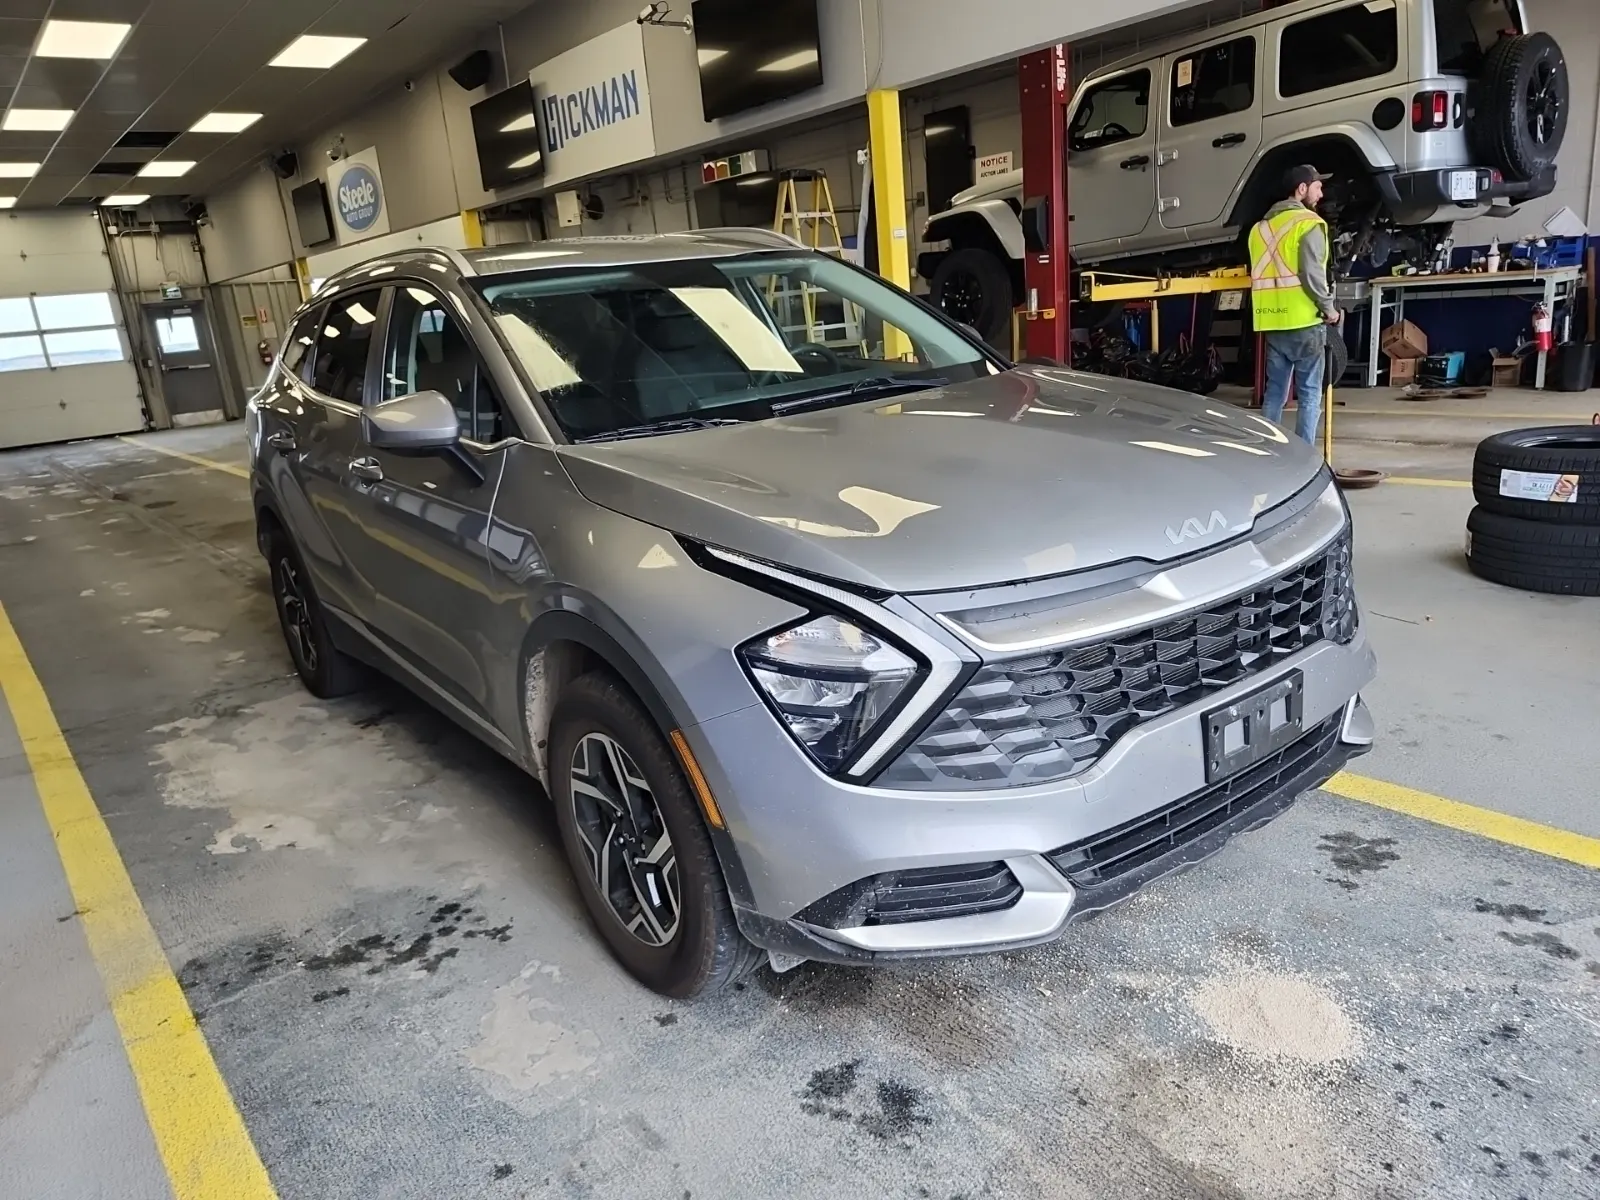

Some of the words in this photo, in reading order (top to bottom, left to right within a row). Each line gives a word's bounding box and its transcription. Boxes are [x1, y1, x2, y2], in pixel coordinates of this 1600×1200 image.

[541, 69, 640, 153] HICKMAN
[980, 156, 1008, 168] NOTICE
[340, 179, 375, 213] Steele
[346, 211, 358, 222] AUTO
[358, 206, 373, 219] GROUP
[1164, 510, 1227, 545] KIA
